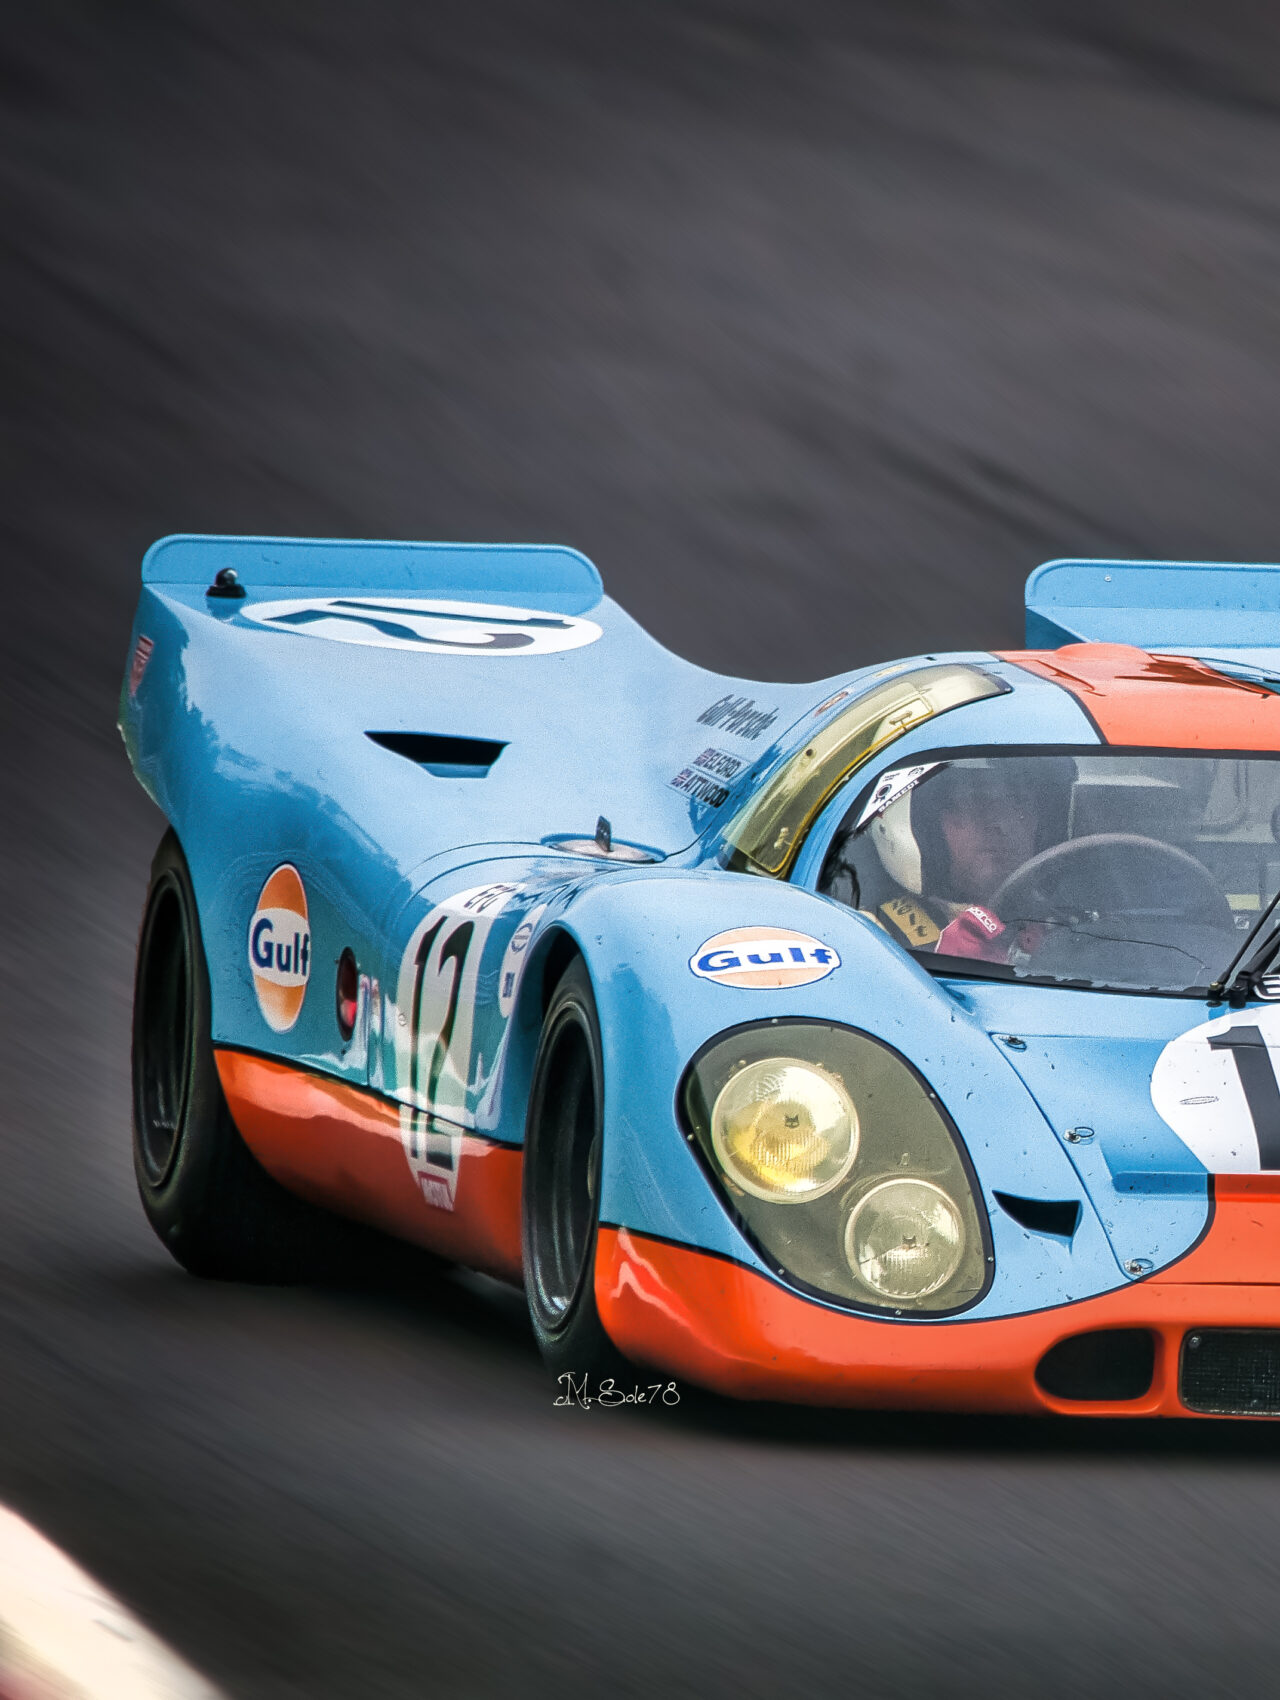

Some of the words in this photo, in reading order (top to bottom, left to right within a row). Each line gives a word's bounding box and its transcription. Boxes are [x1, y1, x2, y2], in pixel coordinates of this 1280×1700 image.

[703, 752, 742, 778] ELFORD
[682, 774, 730, 809] ATTWOOD
[251, 918, 310, 978] Gulf
[697, 947, 833, 972] Gulf
[410, 915, 475, 1172] 12
